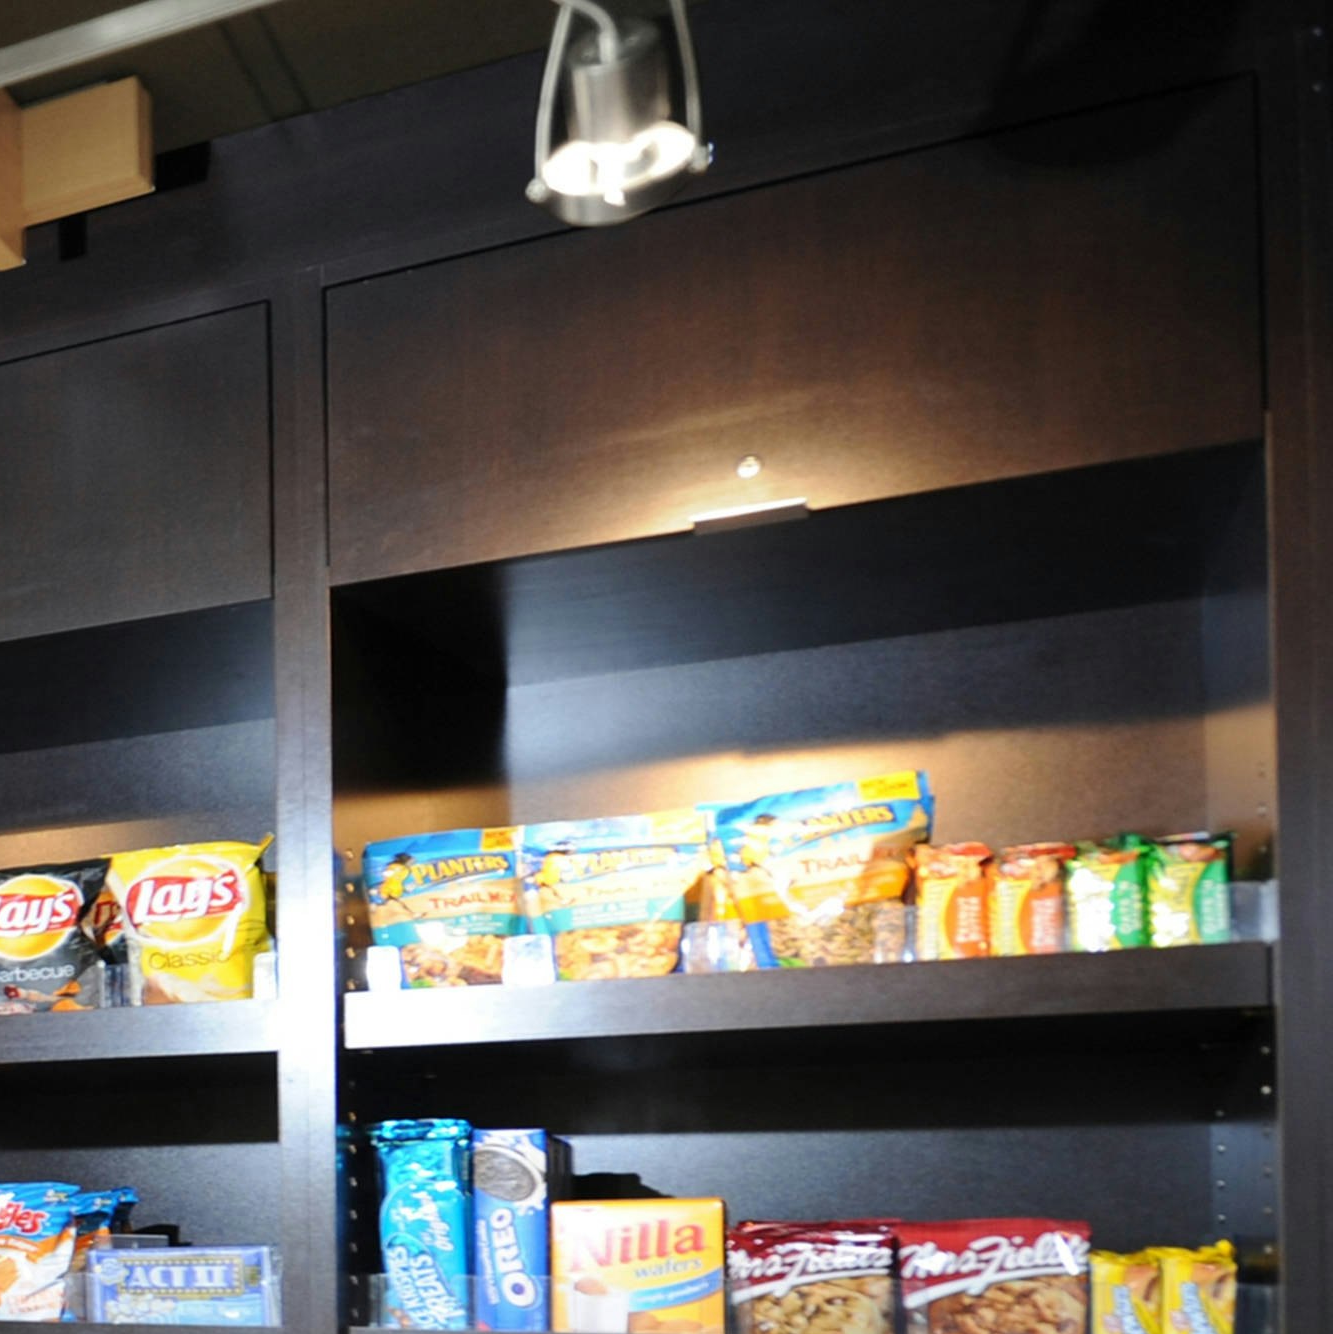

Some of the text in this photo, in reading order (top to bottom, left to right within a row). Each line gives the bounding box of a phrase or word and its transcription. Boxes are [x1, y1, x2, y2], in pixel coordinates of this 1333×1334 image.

[410, 853, 510, 886] PLANTERS
[134, 872, 234, 925] Lay's
[429, 892, 485, 910] TRAIL
[148, 951, 232, 971] Classic
[490, 1207, 537, 1308] OREO
[569, 1219, 705, 1273] Nilla
[124, 1266, 183, 1288] ACT
[635, 1258, 703, 1279] wafers
[408, 1254, 465, 1324] TREATS
